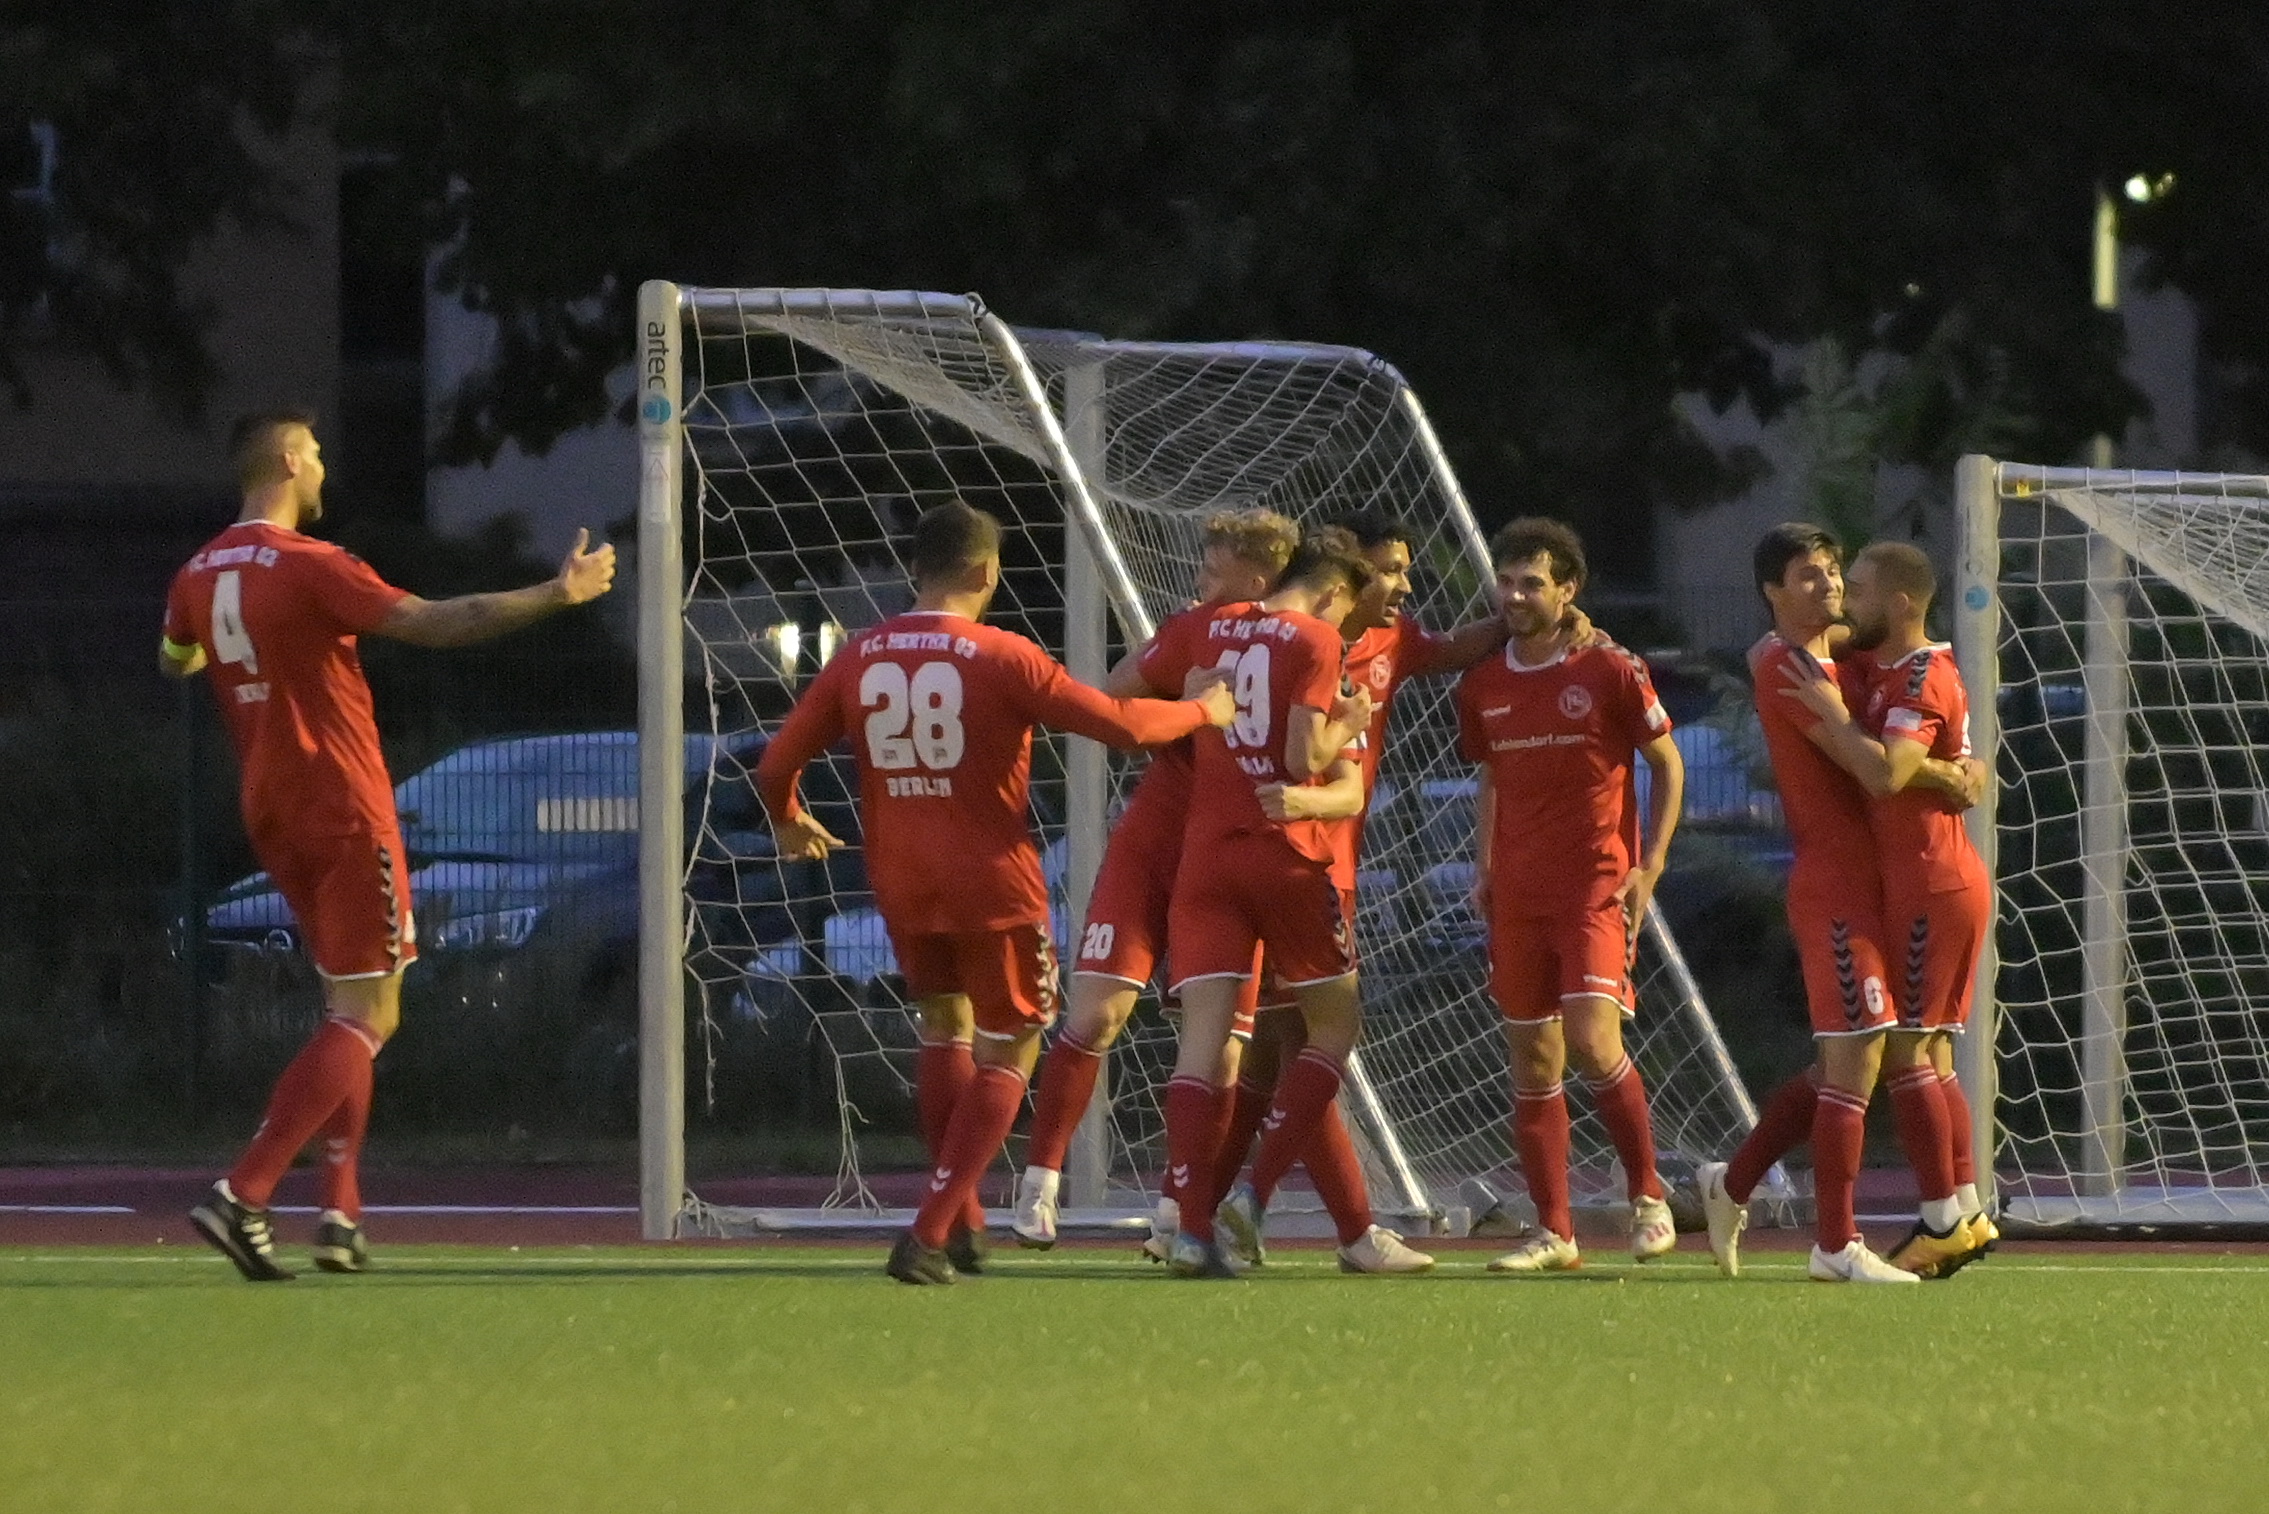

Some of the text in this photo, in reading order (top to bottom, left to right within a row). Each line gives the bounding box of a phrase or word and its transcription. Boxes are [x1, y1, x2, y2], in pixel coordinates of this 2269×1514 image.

[647, 321, 669, 390] artec
[211, 570, 259, 676] 4
[859, 661, 965, 770] 28
[886, 776, 952, 797] BERLIN
[1081, 922, 1115, 960] 20
[1863, 975, 1885, 1015] 6
